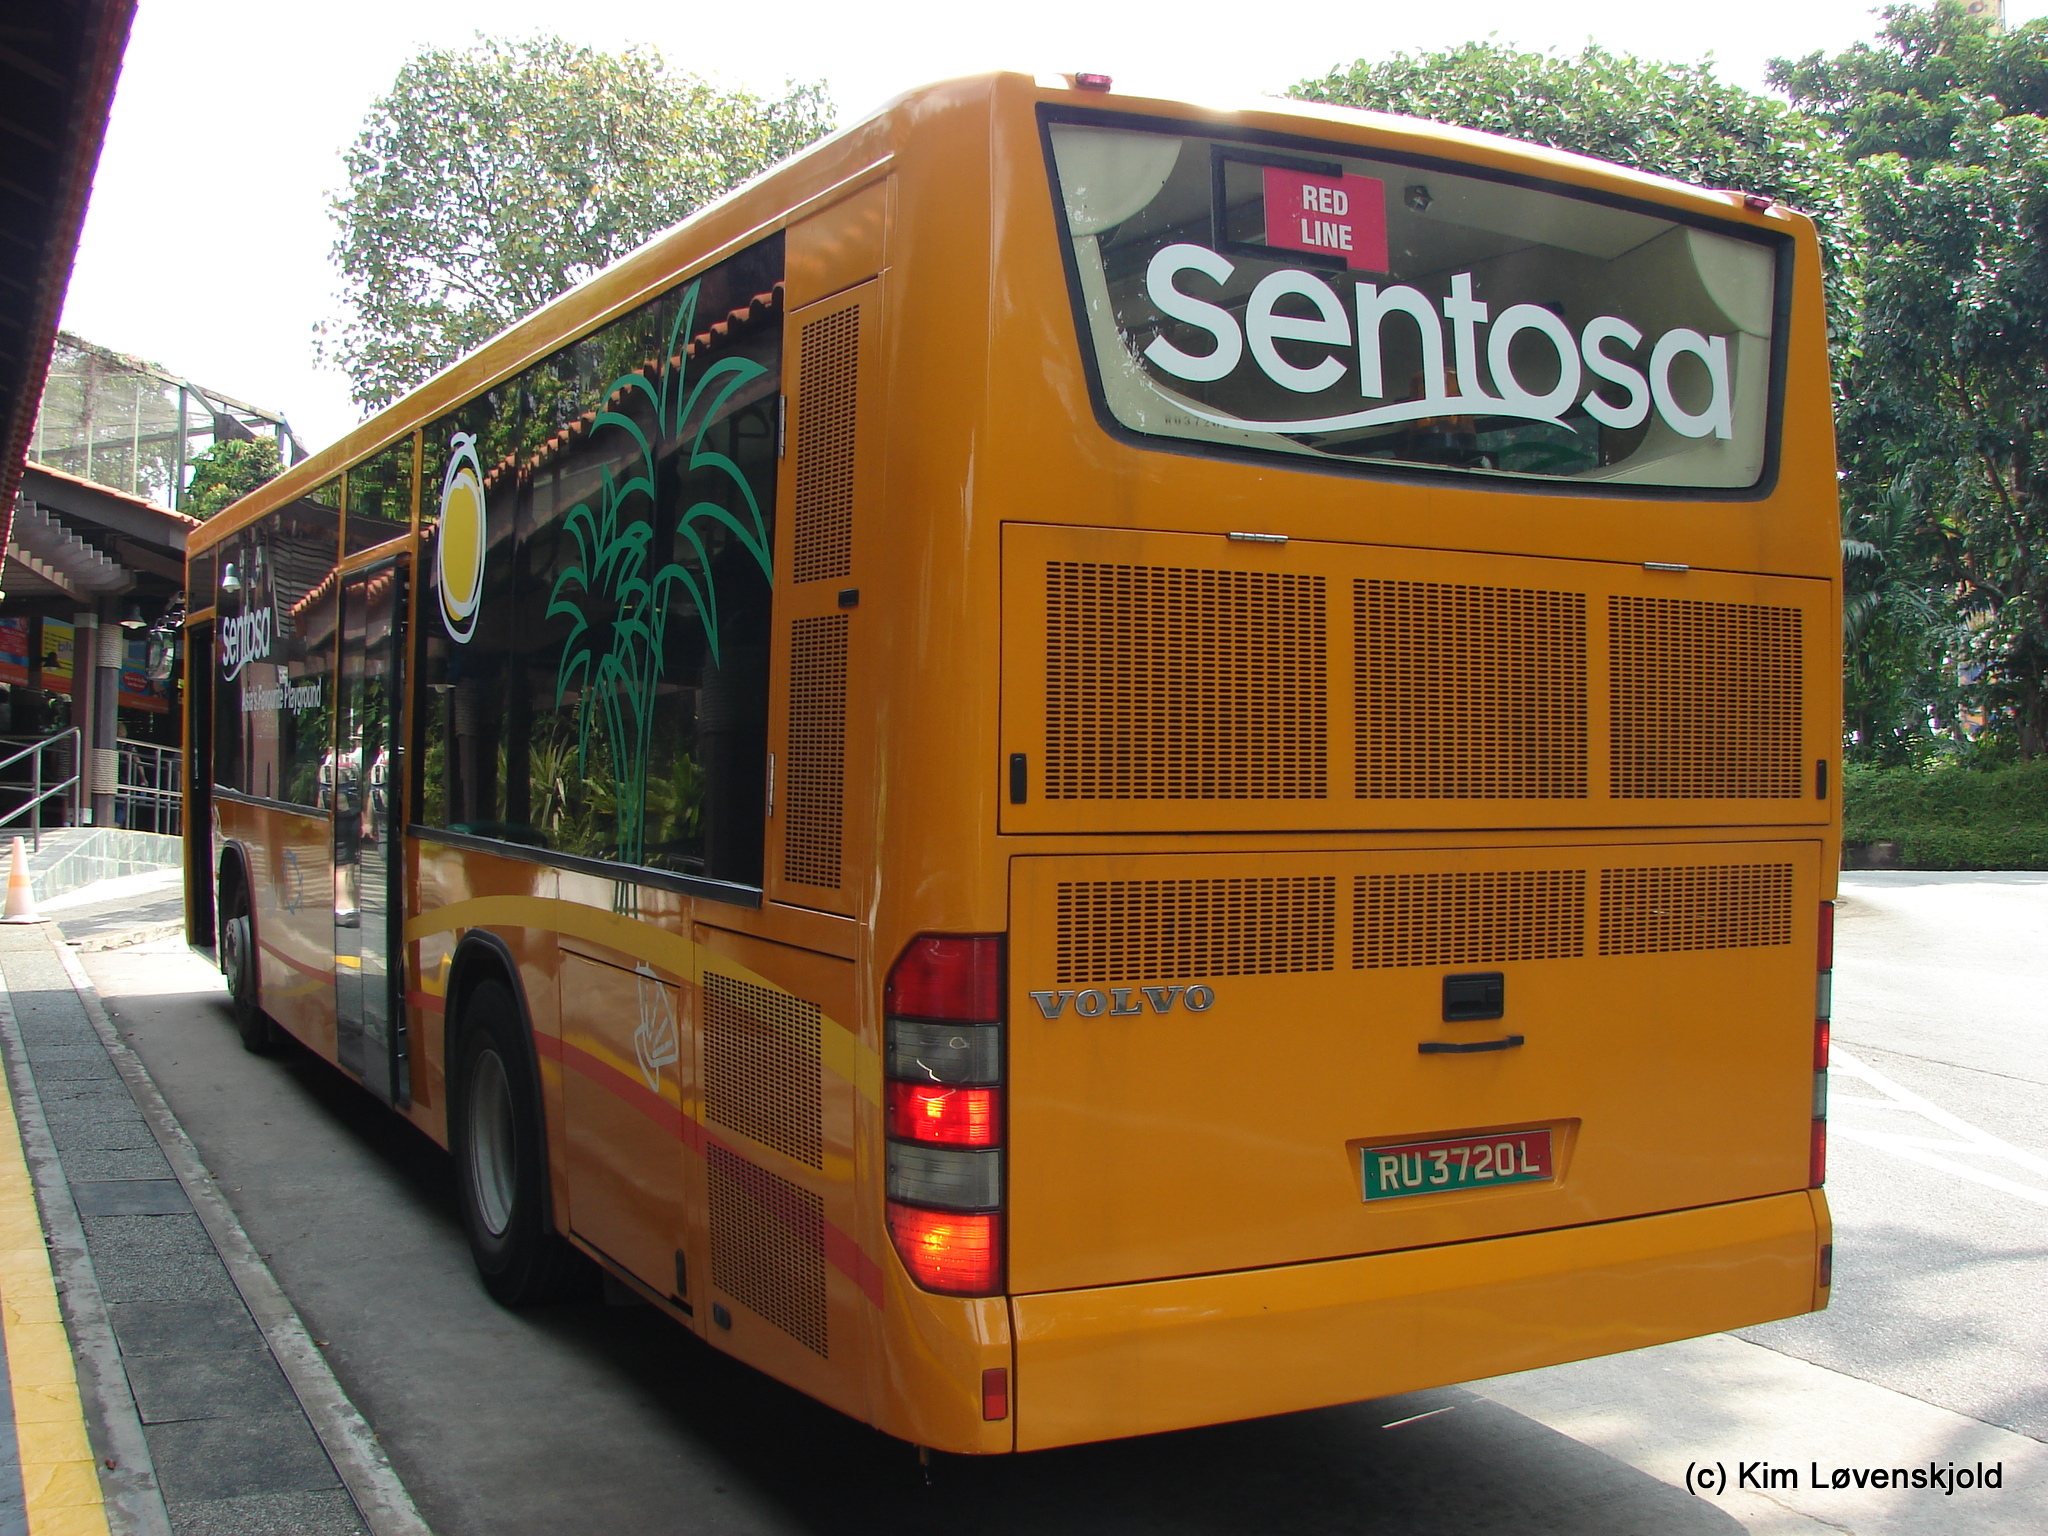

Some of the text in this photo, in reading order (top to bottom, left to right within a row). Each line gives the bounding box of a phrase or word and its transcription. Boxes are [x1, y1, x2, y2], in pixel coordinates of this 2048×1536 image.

[1302, 184, 1349, 216] RED
[1301, 218, 1353, 251] LINE
[258, 683, 283, 710] Favourite
[283, 678, 322, 715] Playground
[1029, 984, 1216, 1019] VOLVO
